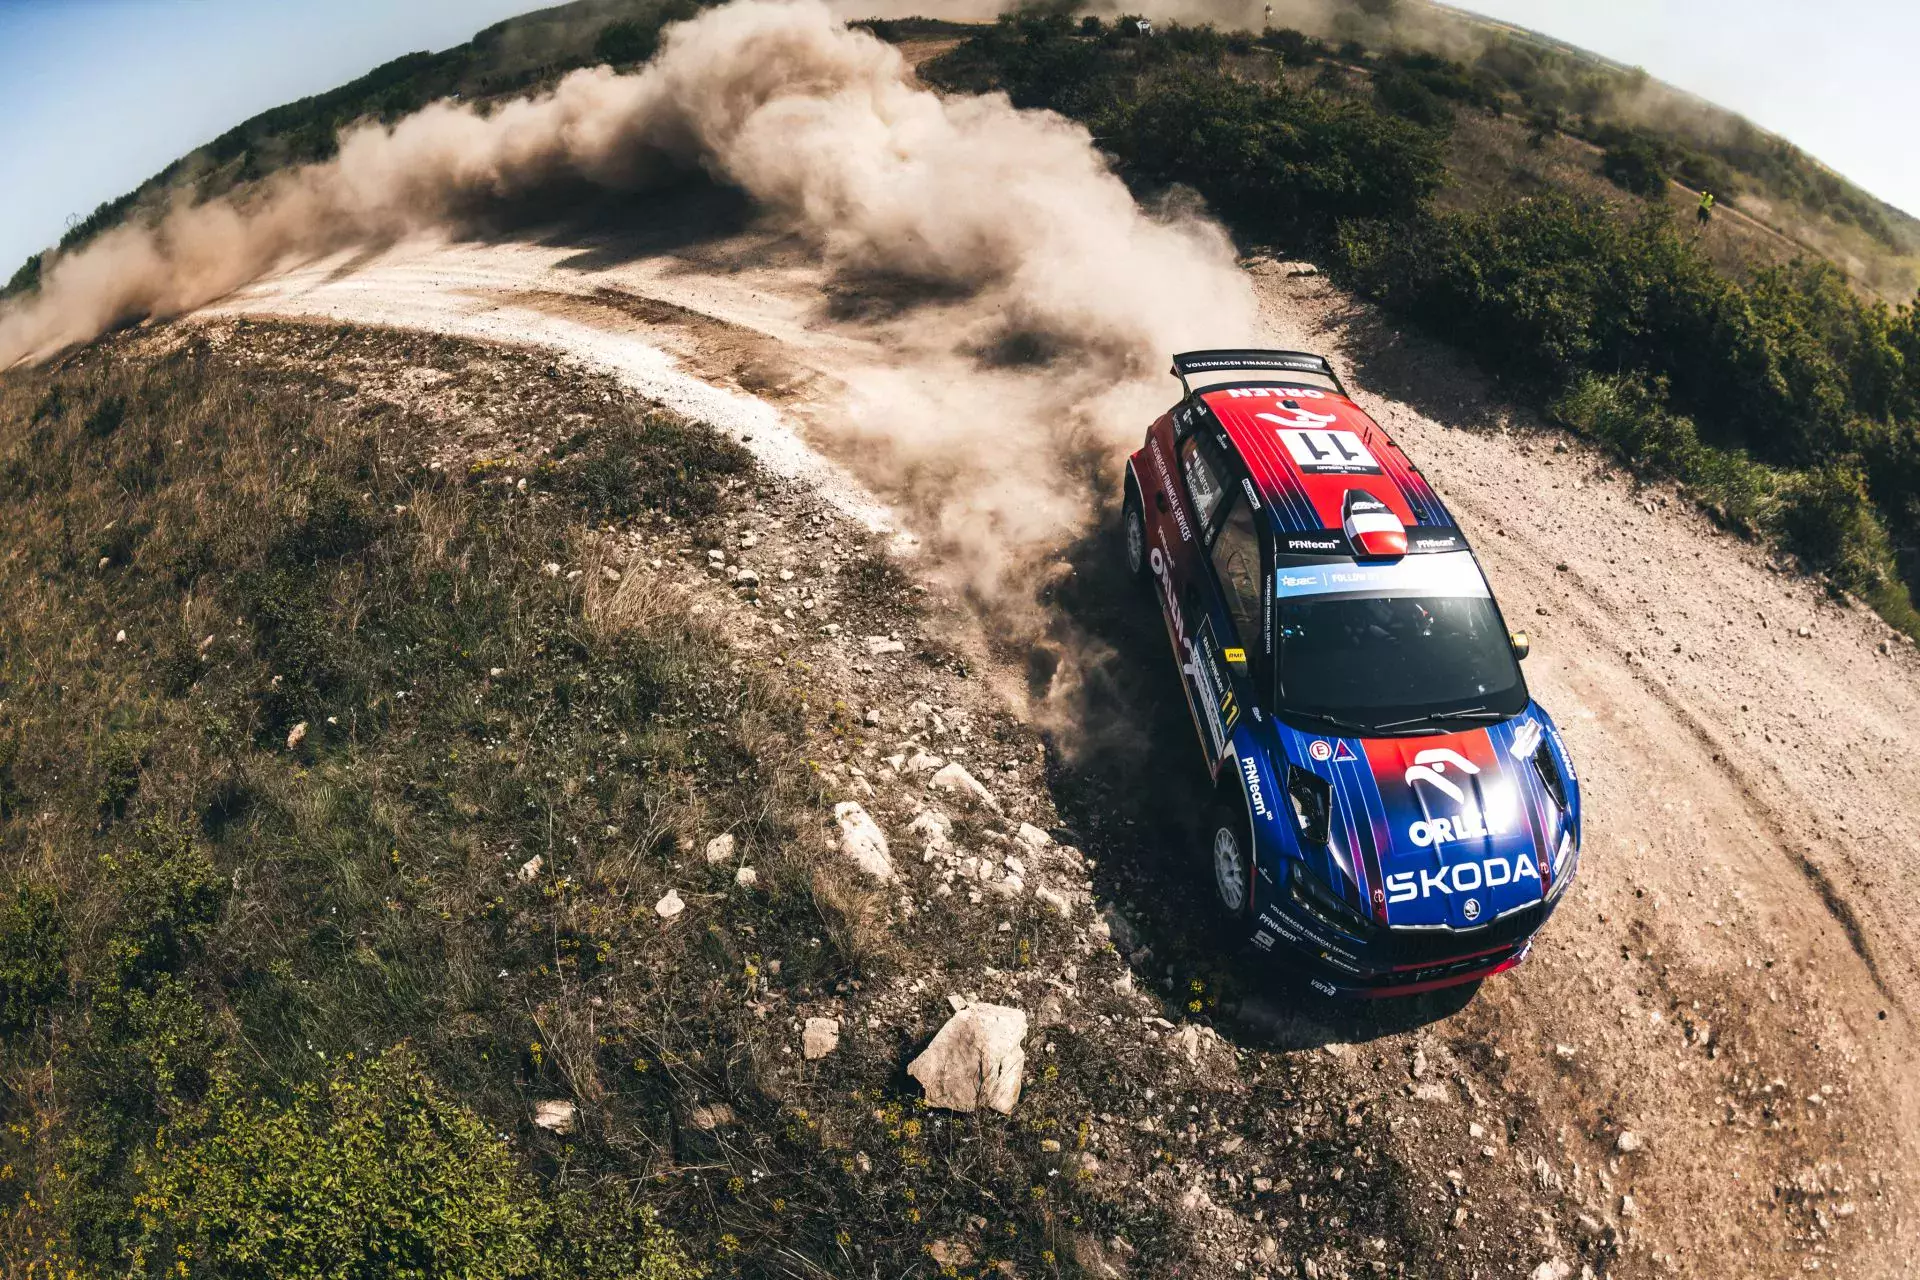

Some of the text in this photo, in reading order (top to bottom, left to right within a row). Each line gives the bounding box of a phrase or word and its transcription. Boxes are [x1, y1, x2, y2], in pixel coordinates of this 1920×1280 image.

[1185, 360, 1241, 368] VOLKSWAGEN
[1284, 361, 1318, 369] SERVICES
[1226, 387, 1326, 399] ORLEN
[1298, 432, 1360, 461] 11
[1162, 474, 1179, 510] FINANCIAL
[1174, 507, 1192, 541] SERVICES
[1221, 691, 1238, 725] 11
[1316, 745, 1325, 756] E
[1408, 811, 1507, 847] ORLE
[1270, 903, 1305, 931] VOLKSWAGEN
[1304, 929, 1332, 949] FINANCIAL
[1311, 978, 1337, 997] verva
